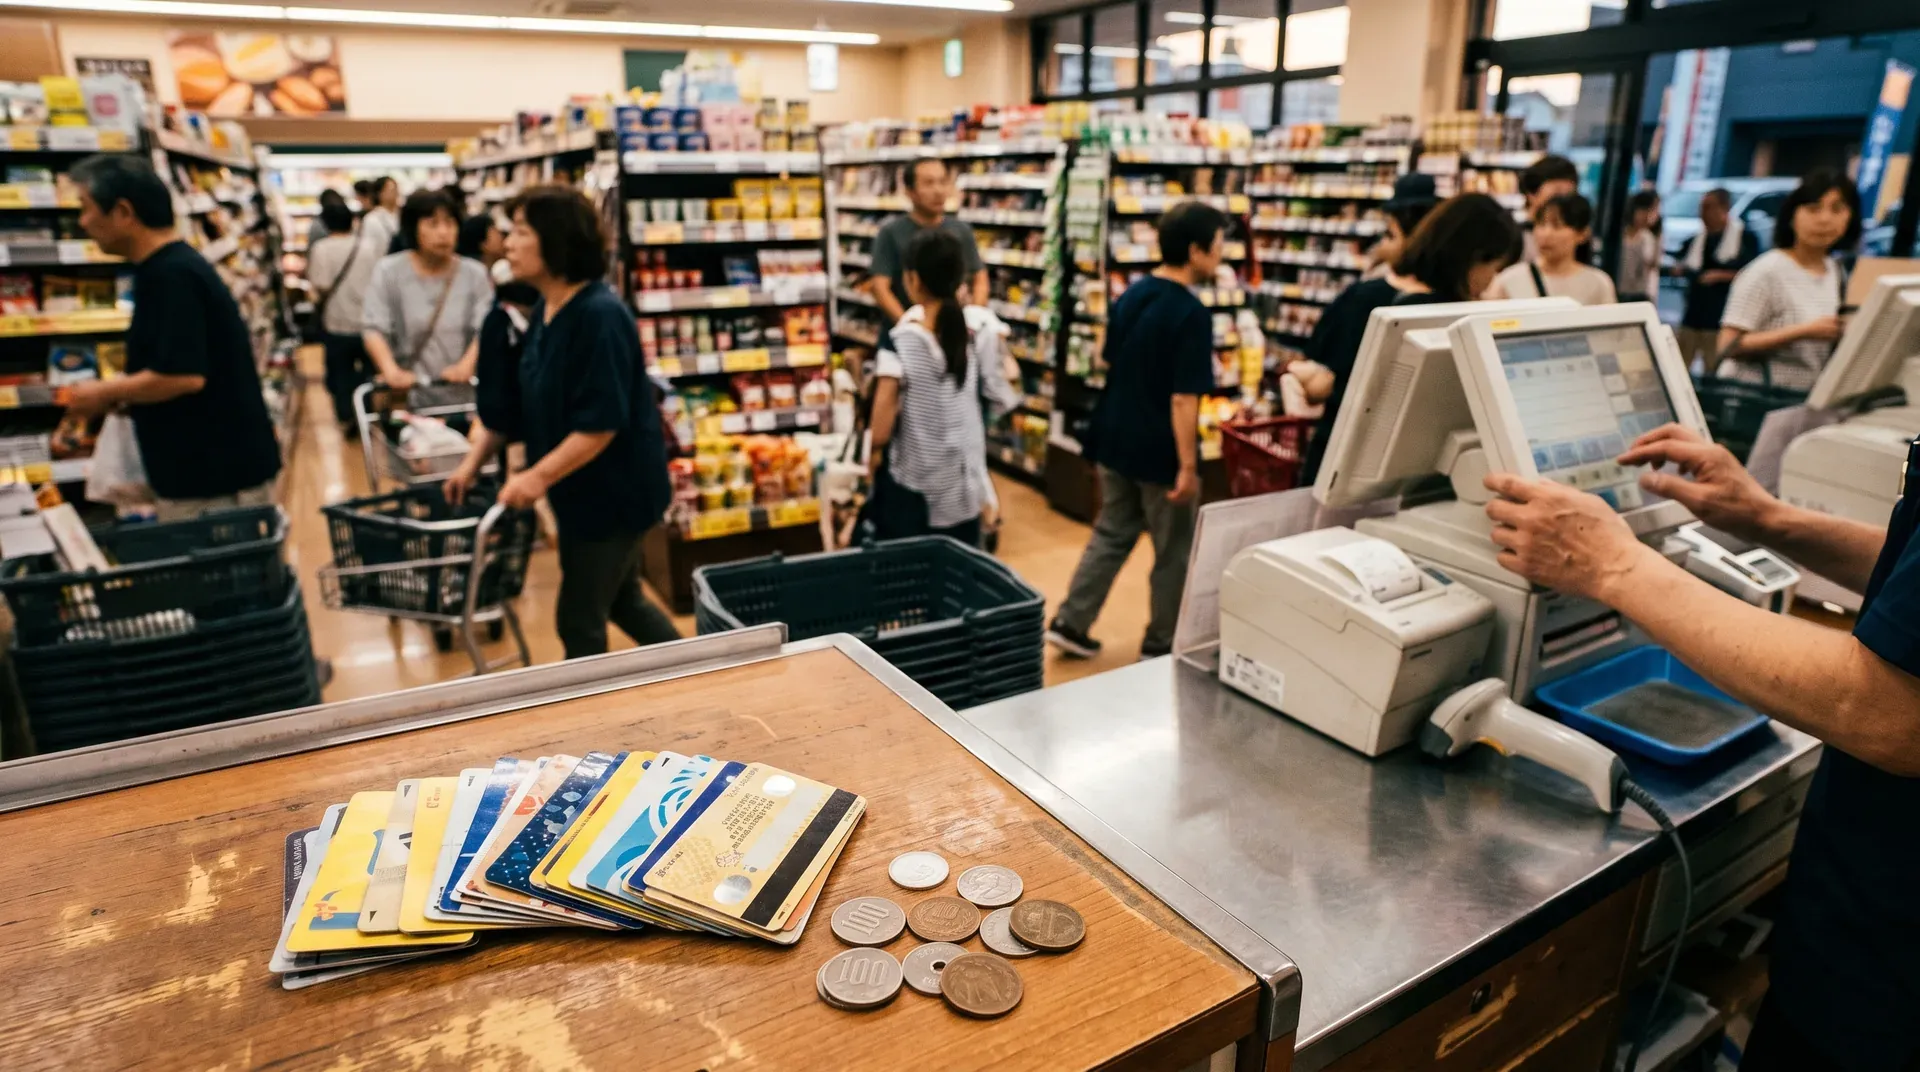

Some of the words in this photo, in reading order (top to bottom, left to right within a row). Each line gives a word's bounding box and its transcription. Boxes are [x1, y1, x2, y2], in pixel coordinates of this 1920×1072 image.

[841, 902, 890, 936] 100
[932, 901, 961, 920] 10
[835, 956, 890, 987] 100
